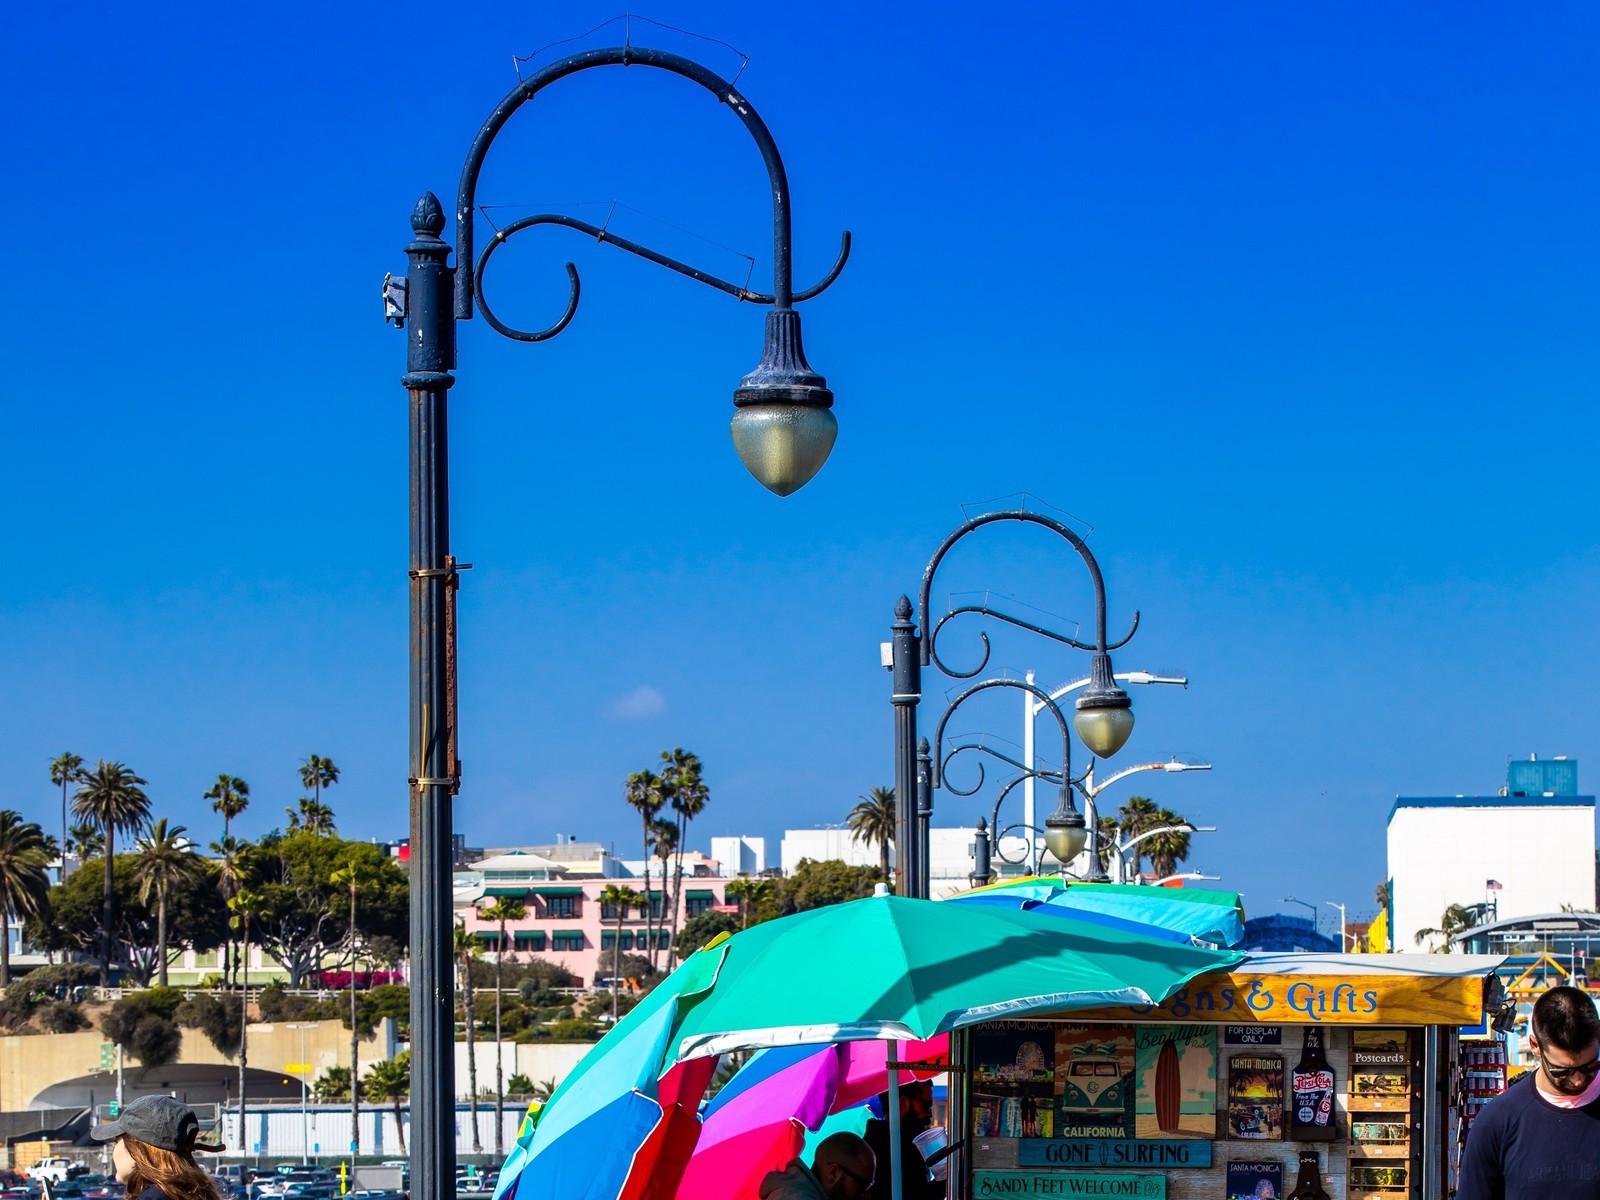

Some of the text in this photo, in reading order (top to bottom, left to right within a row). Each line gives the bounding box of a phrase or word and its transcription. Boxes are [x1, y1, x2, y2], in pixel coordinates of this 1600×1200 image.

[1247, 980, 1274, 1011] &
[1286, 981, 1378, 1021] Gifts
[1007, 1021, 1053, 1031] MONICA
[1228, 1027, 1278, 1036] FOR DISPLAY
[1136, 1024, 1211, 1050] Beautiful
[1241, 1035, 1263, 1043] ONLY
[1355, 1053, 1404, 1063] Postcards
[1231, 1058, 1282, 1070] SANTA MONICA
[1063, 1127, 1126, 1138] CALIFORNIA
[1046, 1143, 1189, 1164] GONE SURFING
[1230, 1163, 1280, 1172] SANTA MONICA
[981, 1177, 1142, 1196] SANDY FEET WELCOME
